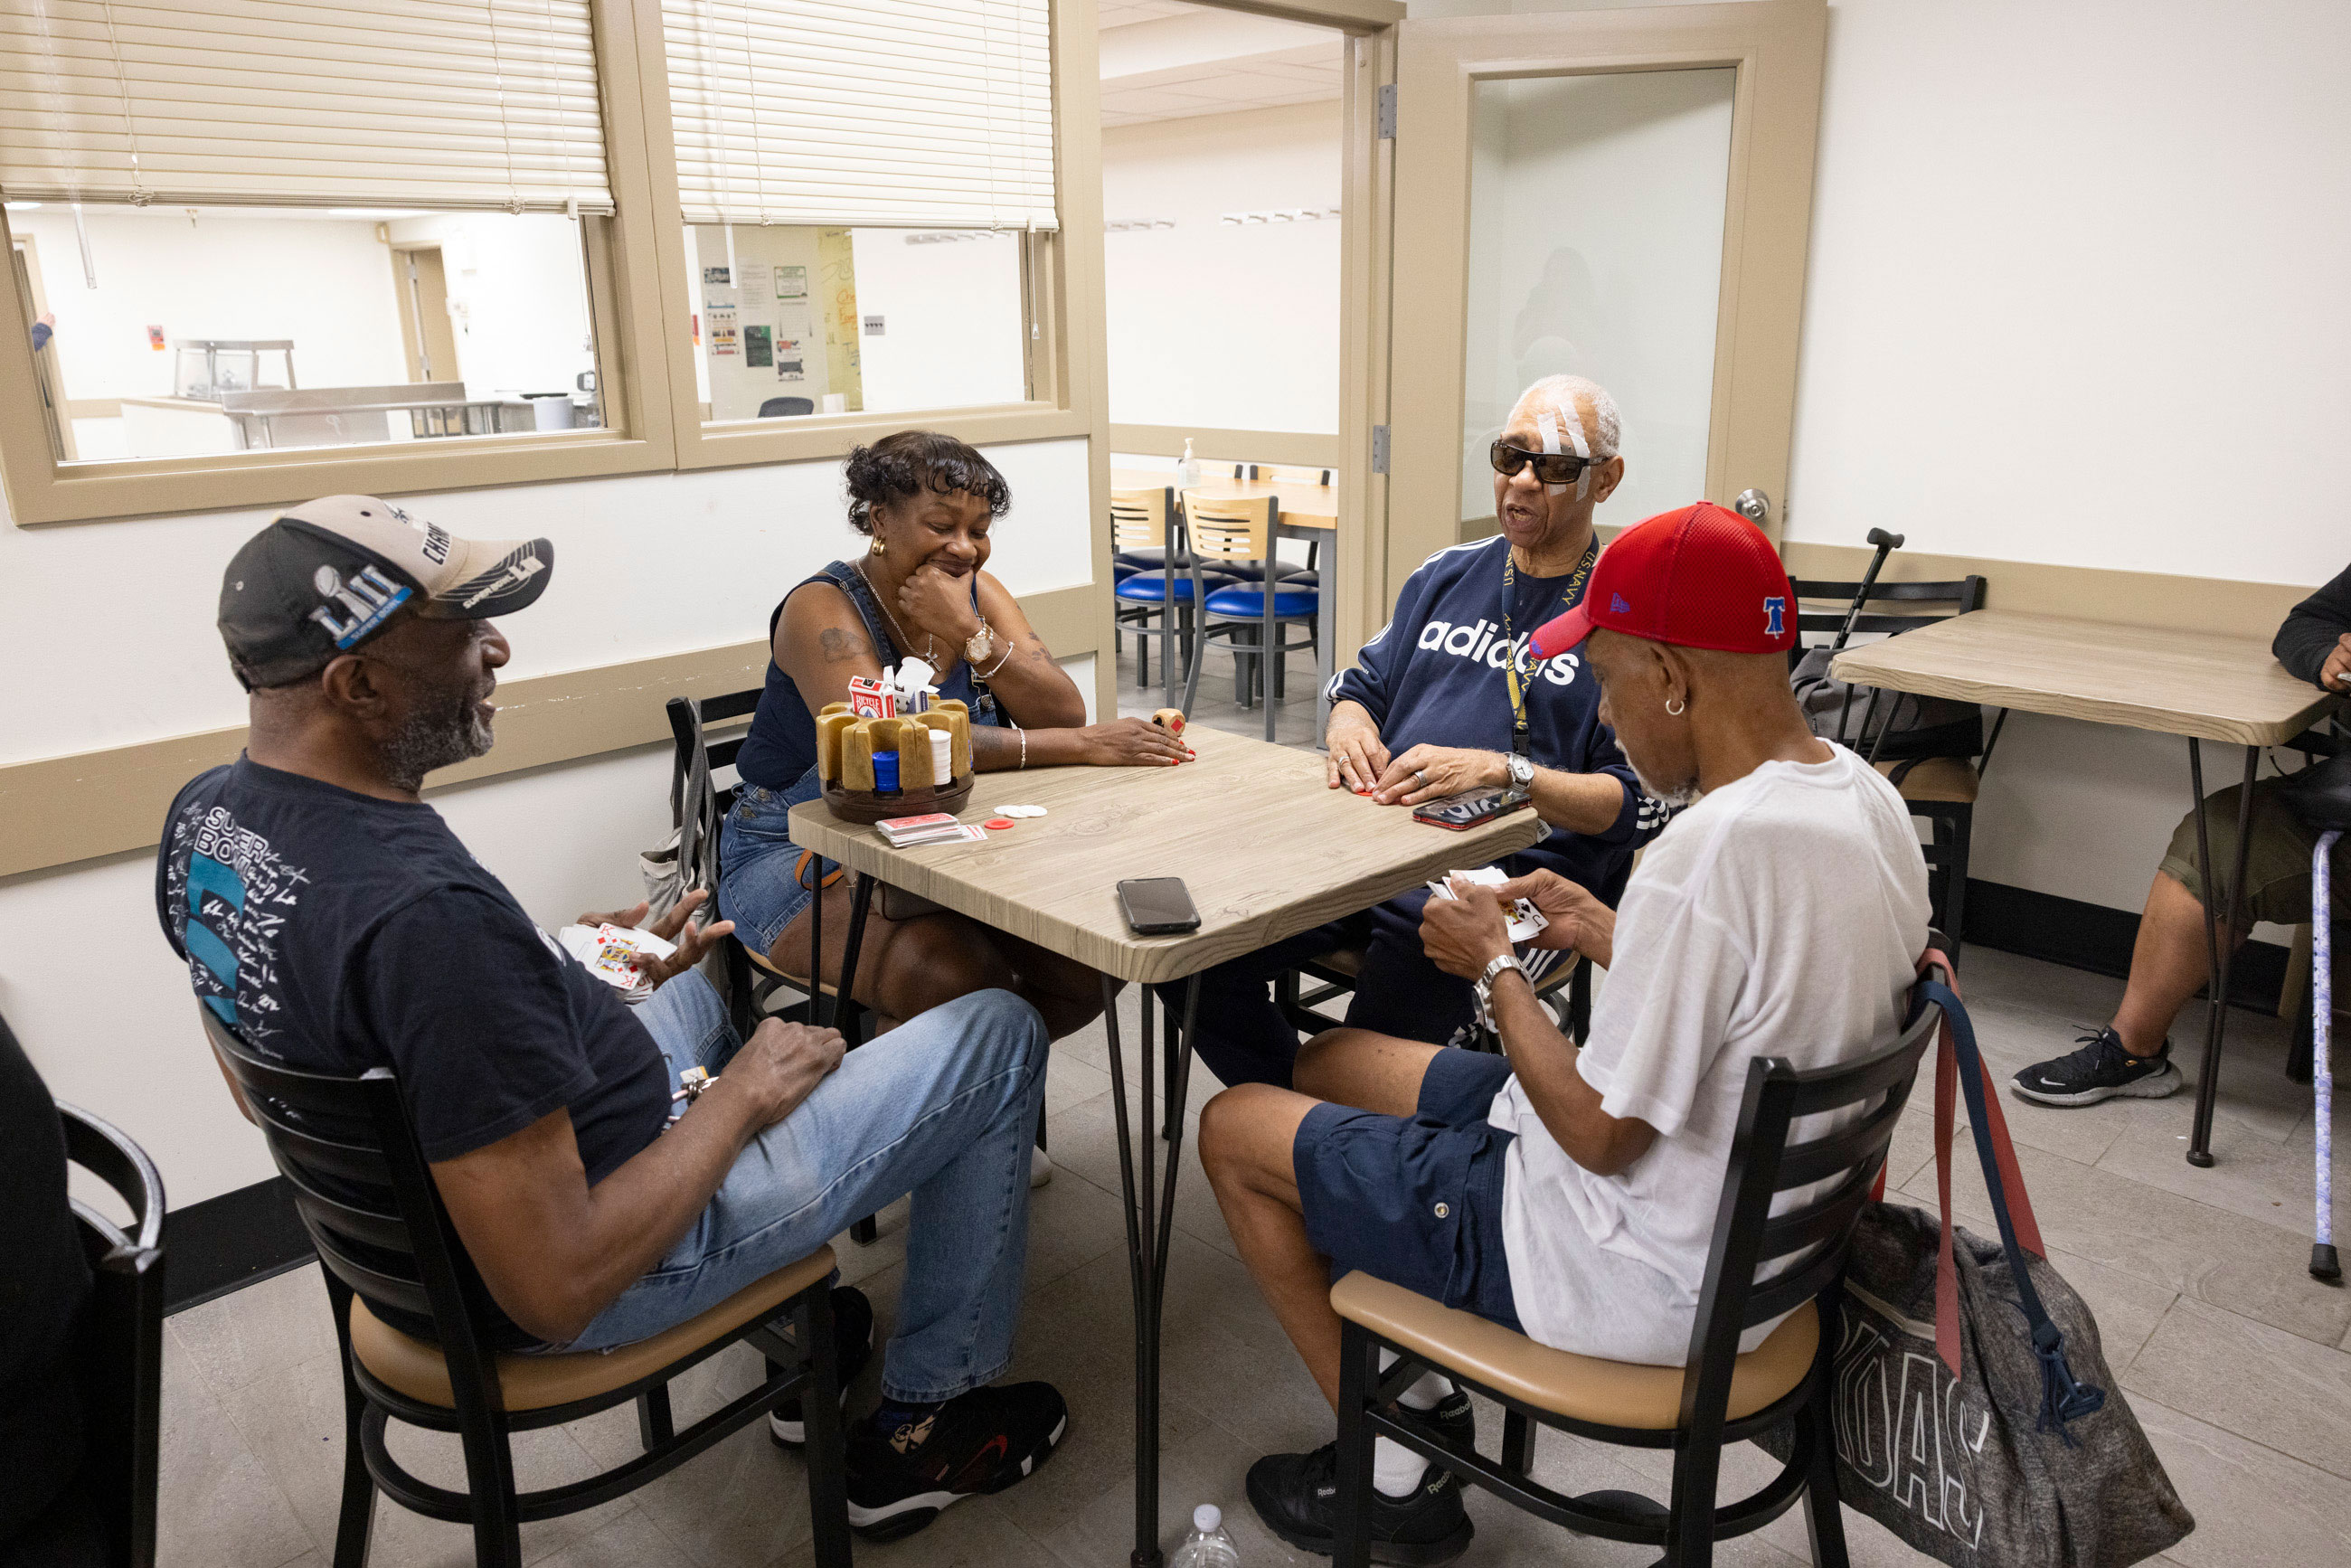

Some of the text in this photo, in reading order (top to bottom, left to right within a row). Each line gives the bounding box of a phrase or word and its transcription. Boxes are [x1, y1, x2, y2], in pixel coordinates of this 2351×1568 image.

[855, 694, 881, 712] BICYCLE
[600, 925, 615, 936] K
[620, 976, 636, 987] K
